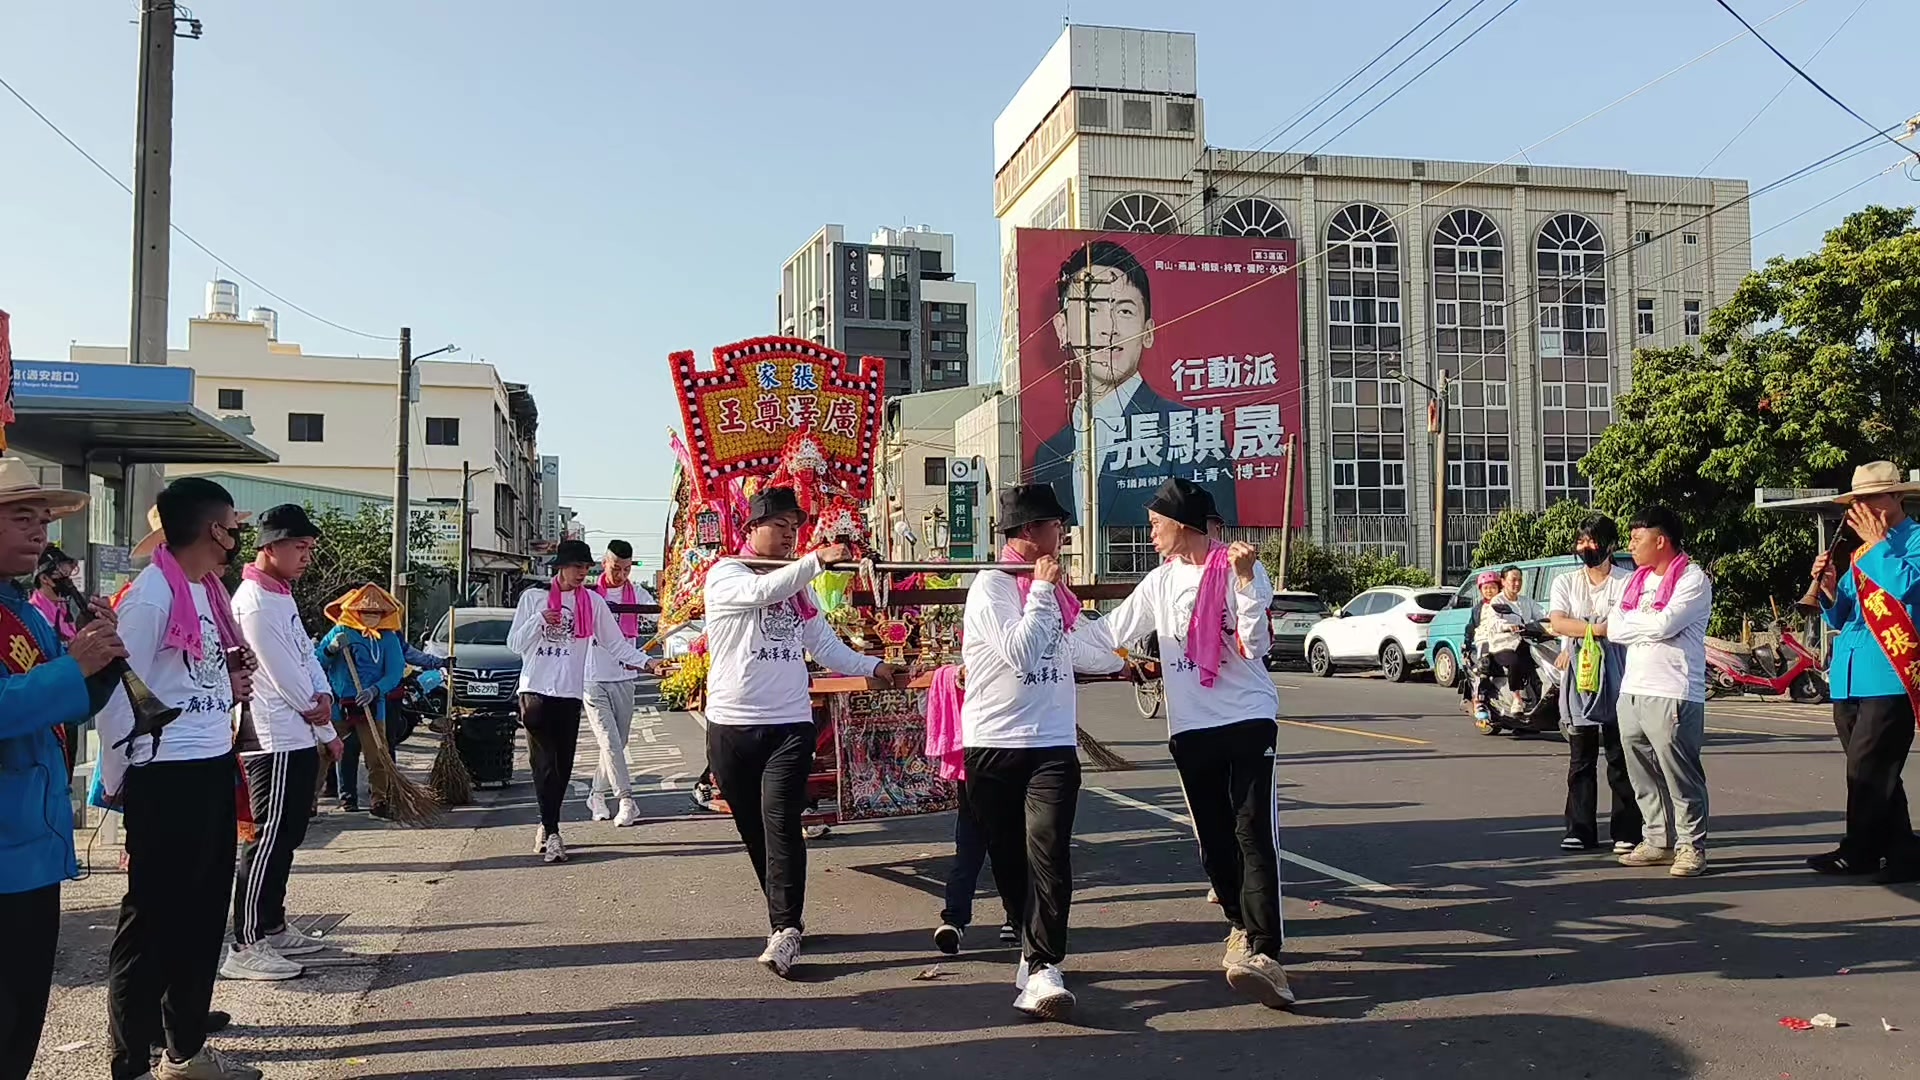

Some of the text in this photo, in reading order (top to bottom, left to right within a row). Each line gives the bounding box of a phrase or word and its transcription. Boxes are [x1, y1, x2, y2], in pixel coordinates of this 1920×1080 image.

[1171, 352, 1279, 391] 行動派
[954, 484, 966, 527] 第一銀行
